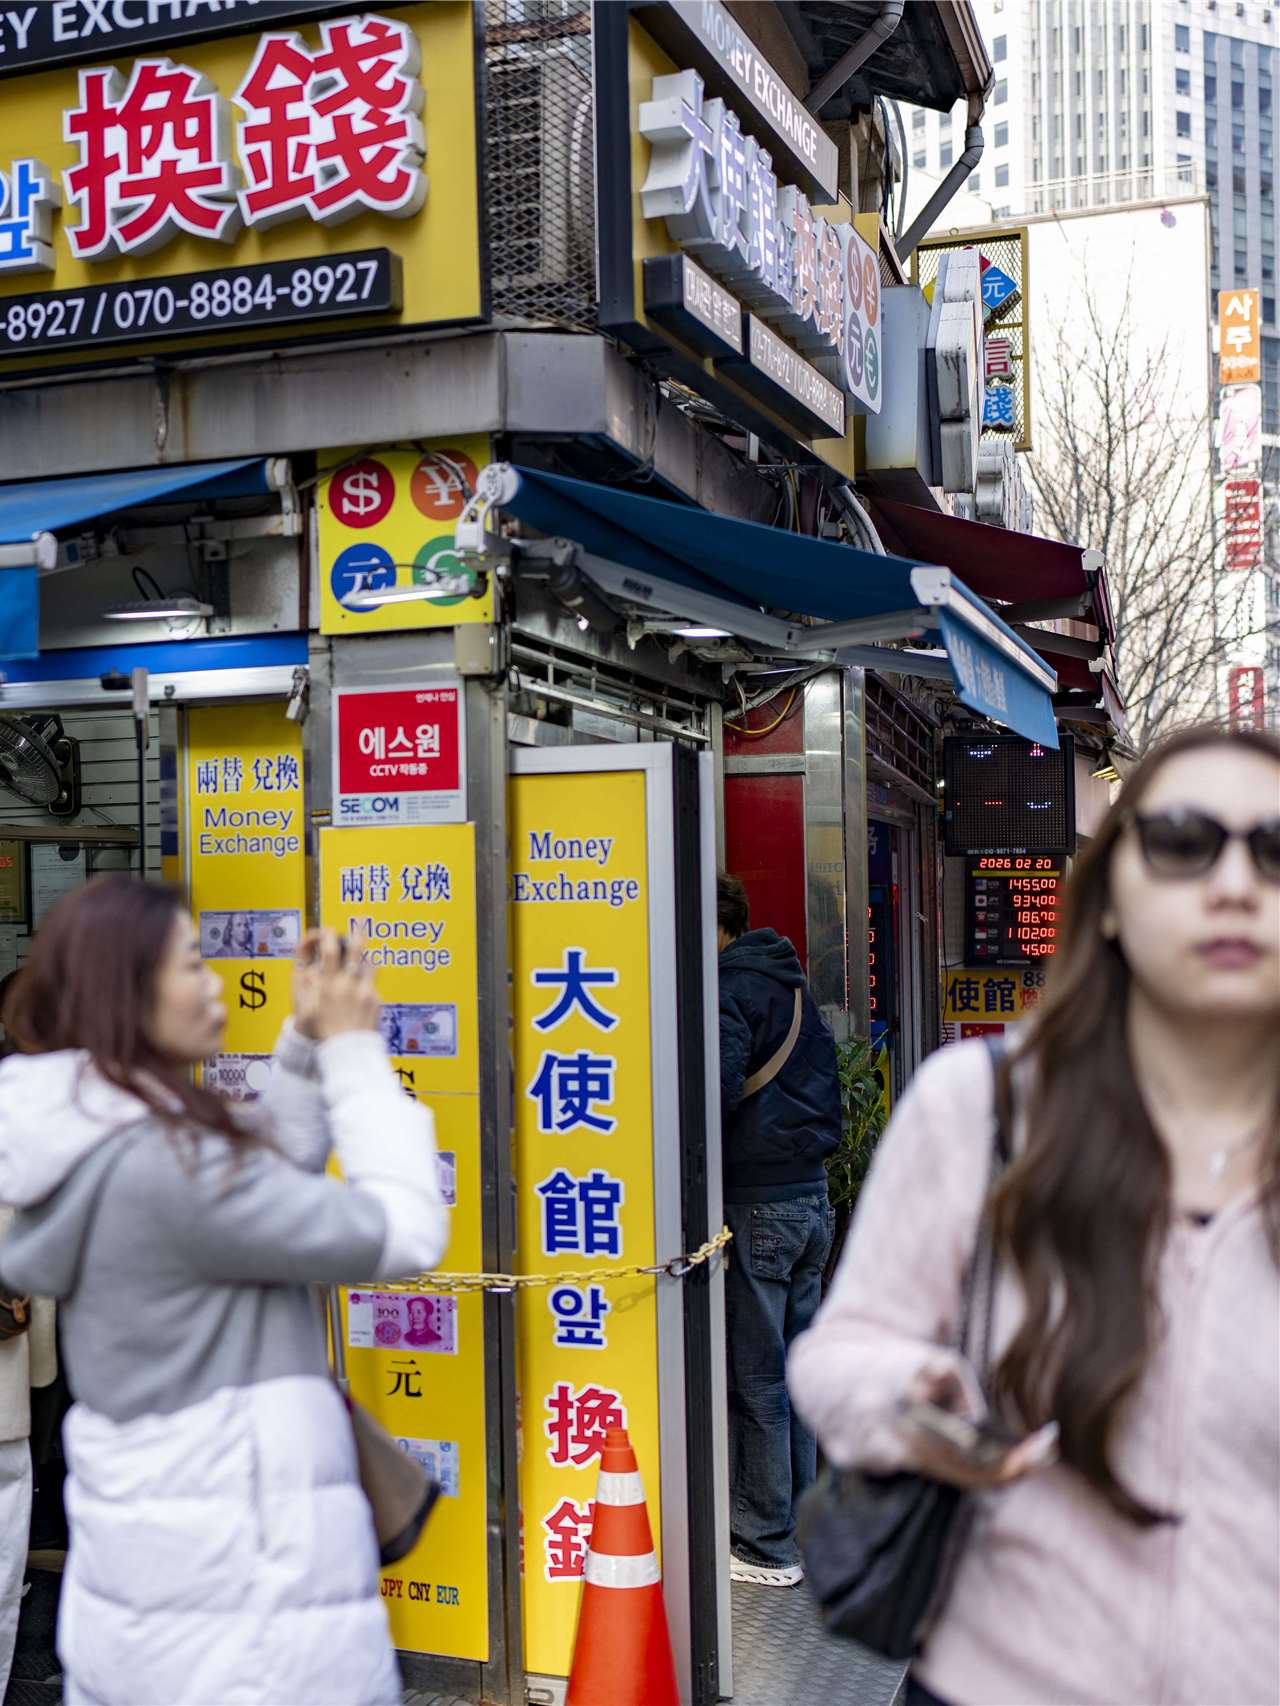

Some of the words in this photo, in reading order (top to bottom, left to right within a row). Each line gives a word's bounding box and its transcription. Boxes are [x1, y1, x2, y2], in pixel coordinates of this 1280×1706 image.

[702, 0, 752, 84] MONEY
[754, 60, 817, 165] EXCHANGE
[113, 260, 379, 329] 070-8884-8927
[358, 724, 440, 760] 에스원
[204, 807, 293, 831] Money
[340, 797, 399, 814] SECOM
[200, 833, 300, 857] Exchange
[529, 832, 613, 865] Money
[980, 859, 1011, 869] 2026
[1016, 859, 1032, 869] 02
[1036, 859, 1052, 869] 20
[512, 872, 638, 906] Exchange
[350, 917, 445, 943] Money
[360, 944, 451, 971] xchange
[239, 969, 267, 1011] $
[386, 1359, 424, 1398] 元
[381, 1578, 403, 1598] JPY
[408, 1581, 431, 1602] CNY
[436, 1584, 459, 1606] EUR
